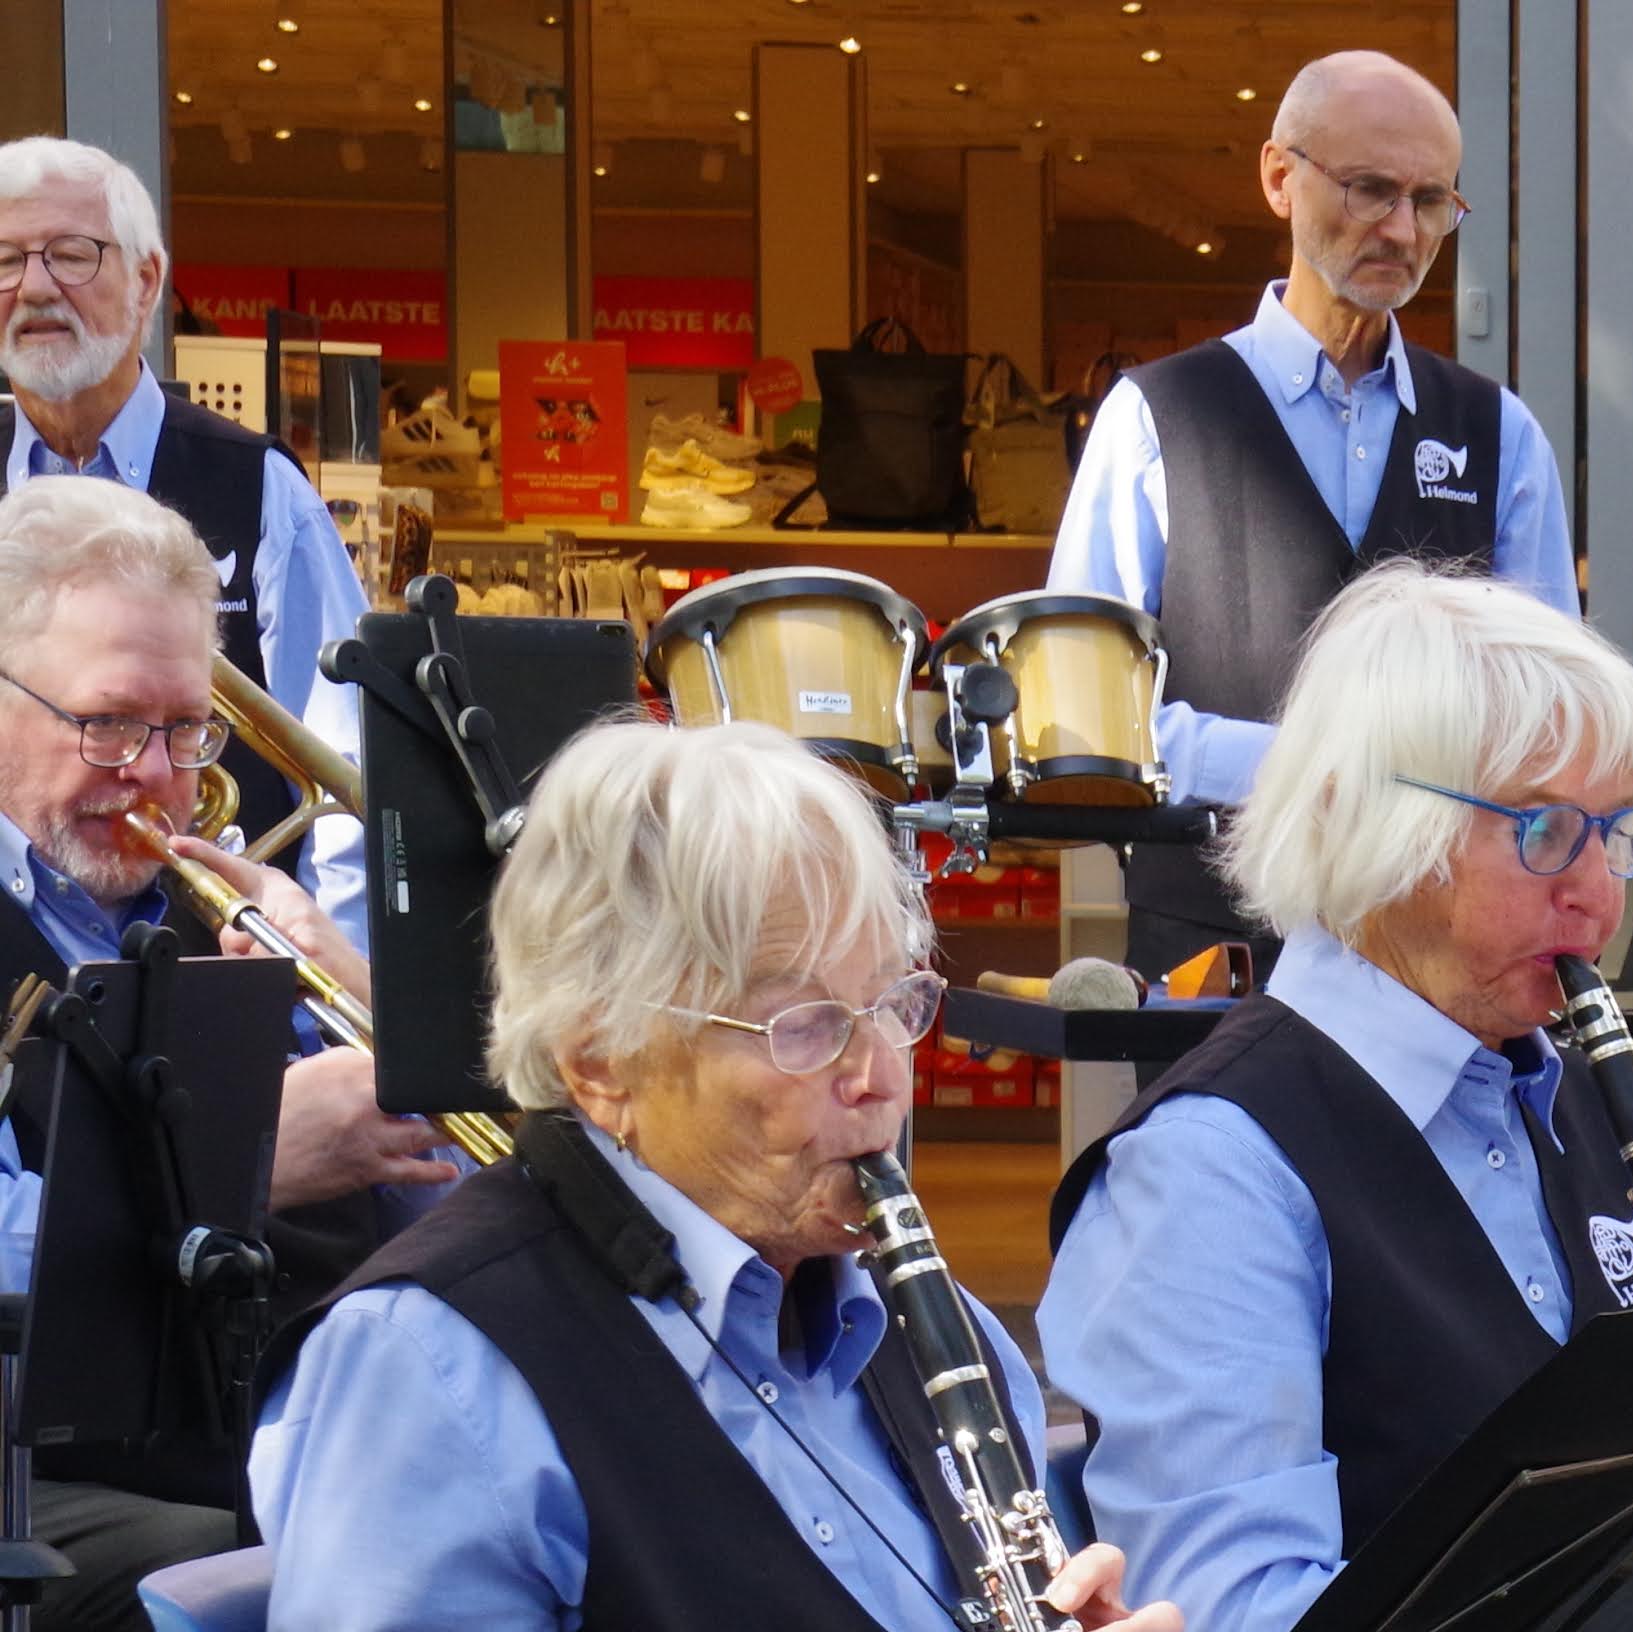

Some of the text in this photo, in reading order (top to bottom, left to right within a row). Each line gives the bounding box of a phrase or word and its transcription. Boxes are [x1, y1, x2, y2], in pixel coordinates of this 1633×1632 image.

[308, 300, 441, 324] LAATSTE
[594, 310, 754, 332] AATSTE KA
[1426, 484, 1478, 504] Helmond
[214, 597, 248, 613] mond
